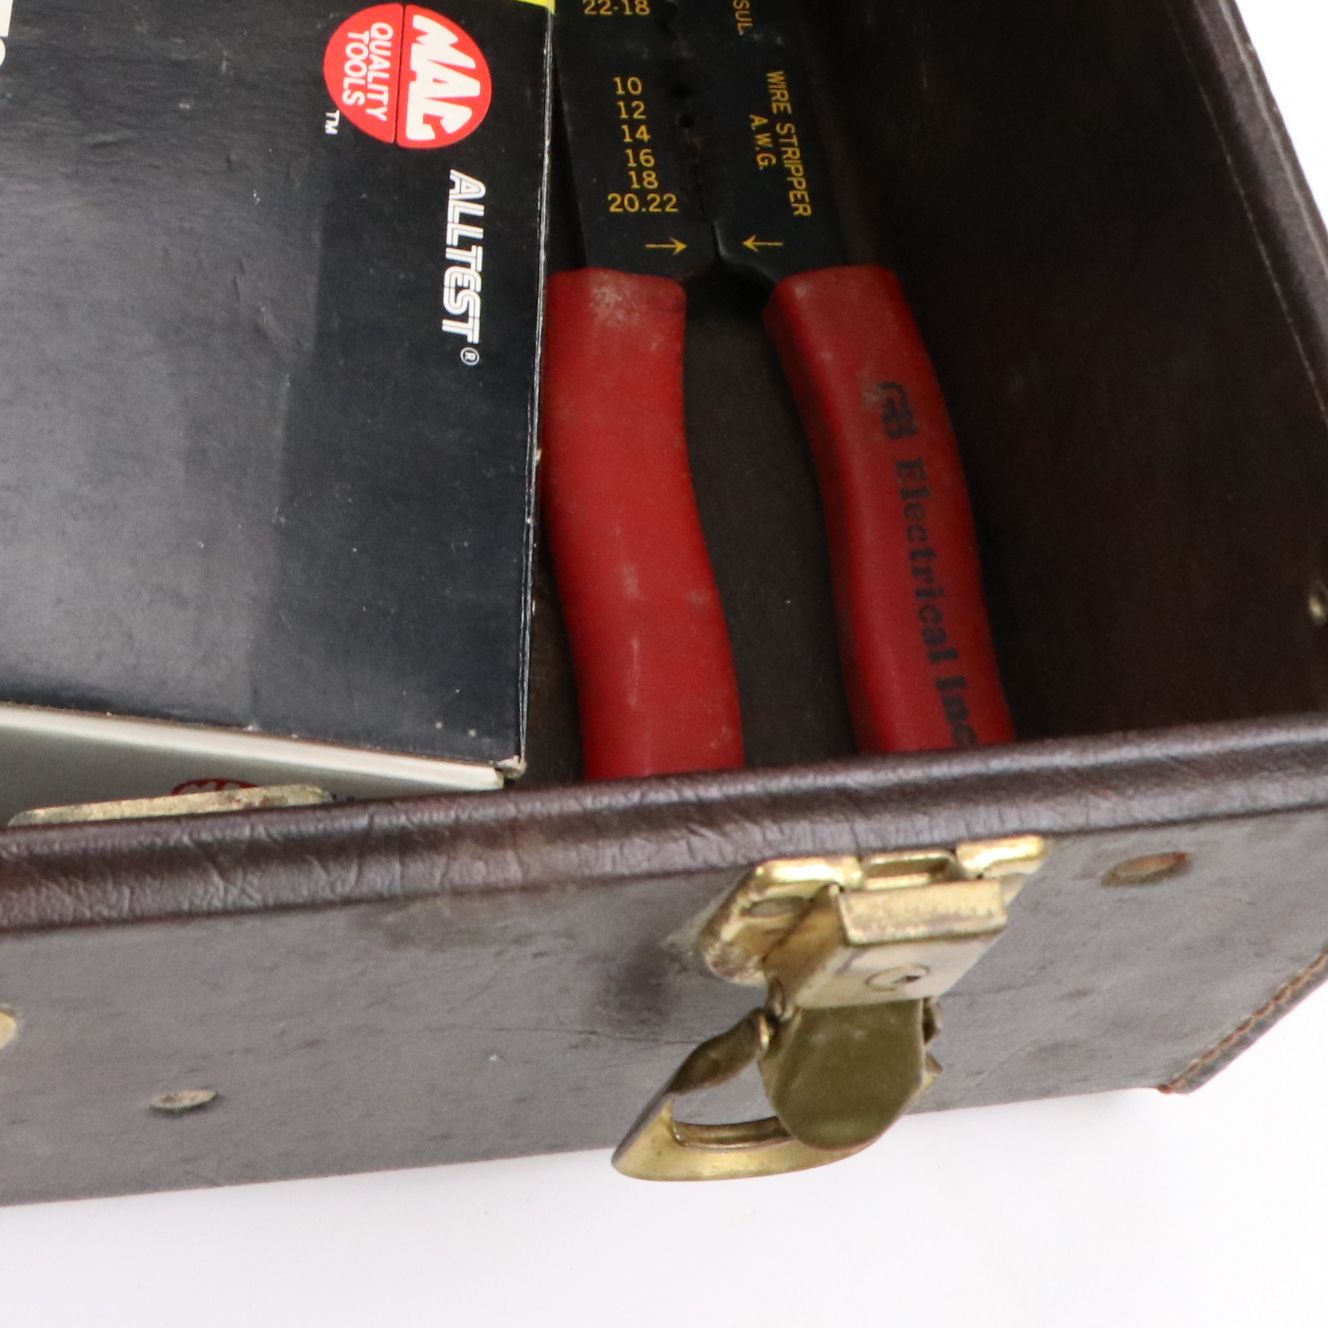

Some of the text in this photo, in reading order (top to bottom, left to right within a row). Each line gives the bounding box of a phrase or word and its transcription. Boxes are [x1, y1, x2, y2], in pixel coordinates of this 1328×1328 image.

[341, 29, 369, 107] TOOLS
[366, 21, 394, 122] QUALITY
[405, 13, 481, 141] MAC
[613, 76, 643, 96] 10
[618, 100, 647, 119] 12
[621, 124, 651, 143] 14
[625, 148, 655, 167] 16
[766, 70, 812, 217] WIRE STRIPPER
[607, 192, 679, 214] 20.22
[629, 170, 659, 190] 18
[442, 168, 486, 345] ALLTEST
[894, 457, 959, 664] Electrical
